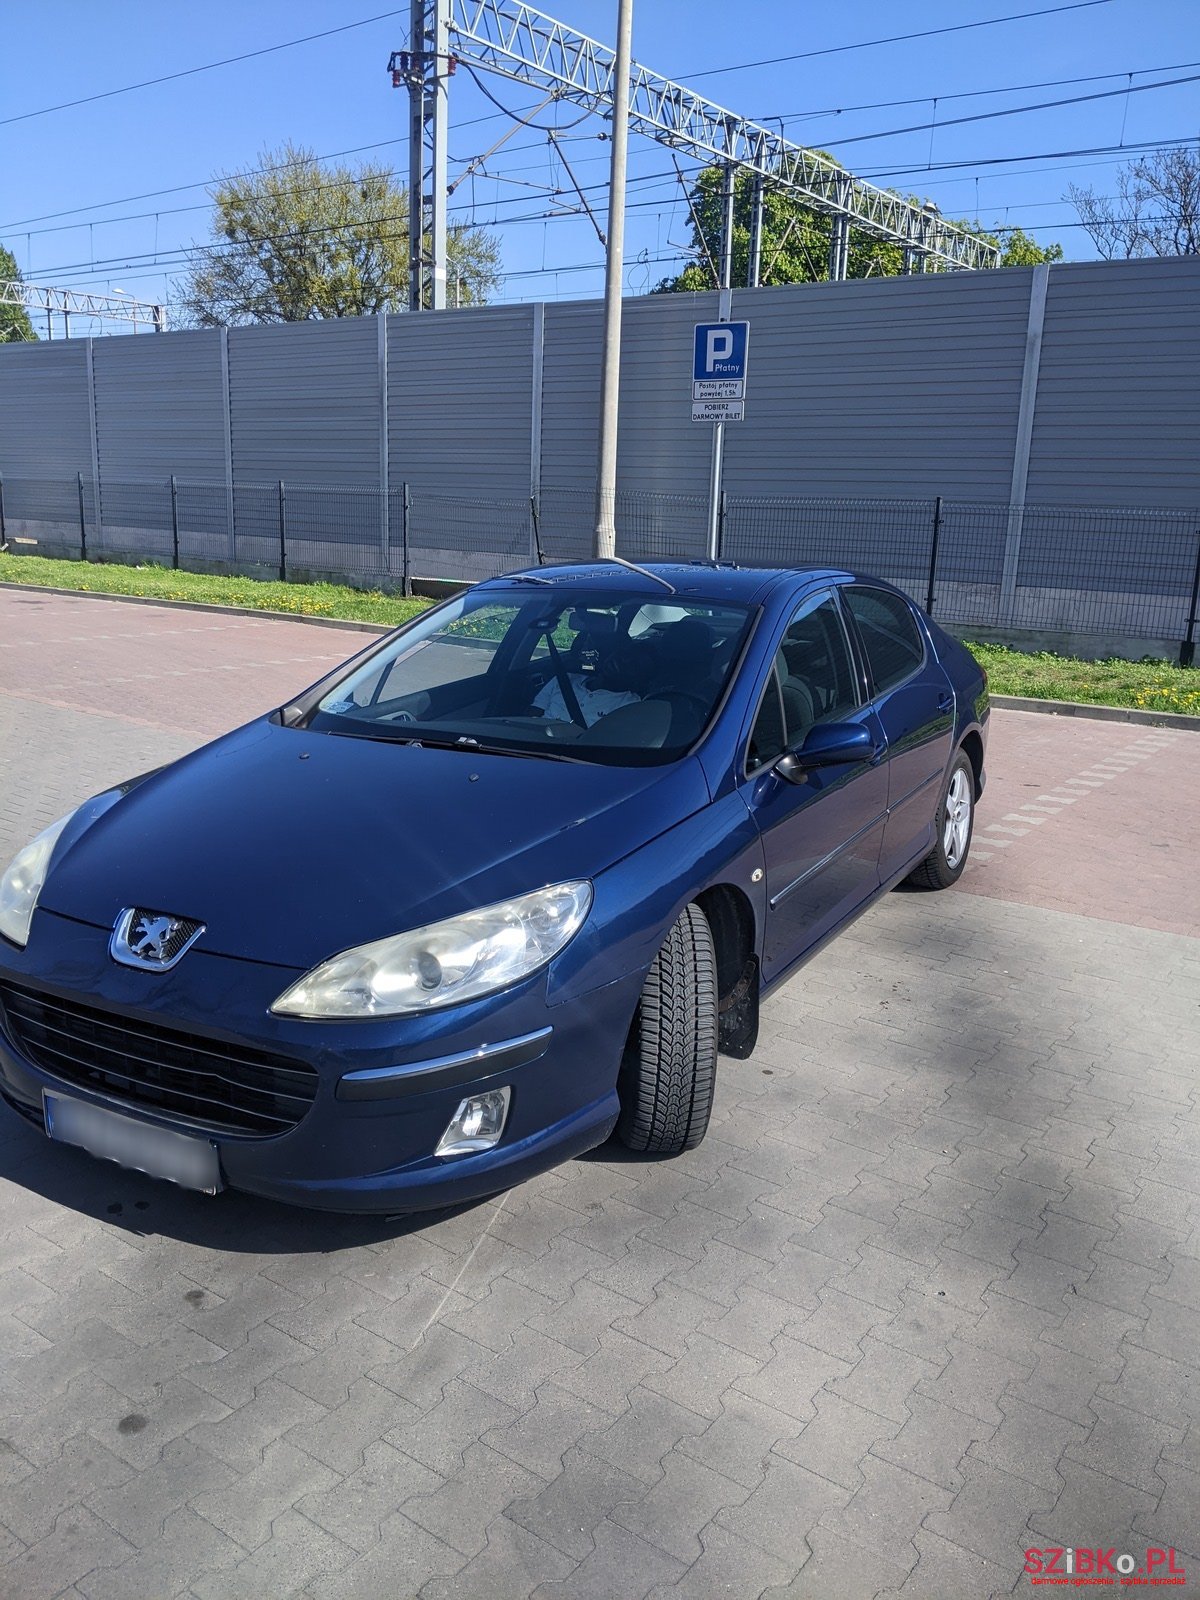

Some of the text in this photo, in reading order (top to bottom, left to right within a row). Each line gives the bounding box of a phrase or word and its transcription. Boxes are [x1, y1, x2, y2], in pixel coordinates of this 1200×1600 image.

[706, 329, 733, 372] P
[715, 363, 740, 374] Płatny
[718, 382, 738, 390] płatny
[704, 403, 729, 411] POBIERZ
[692, 412, 741, 421] DARMOWY BILET
